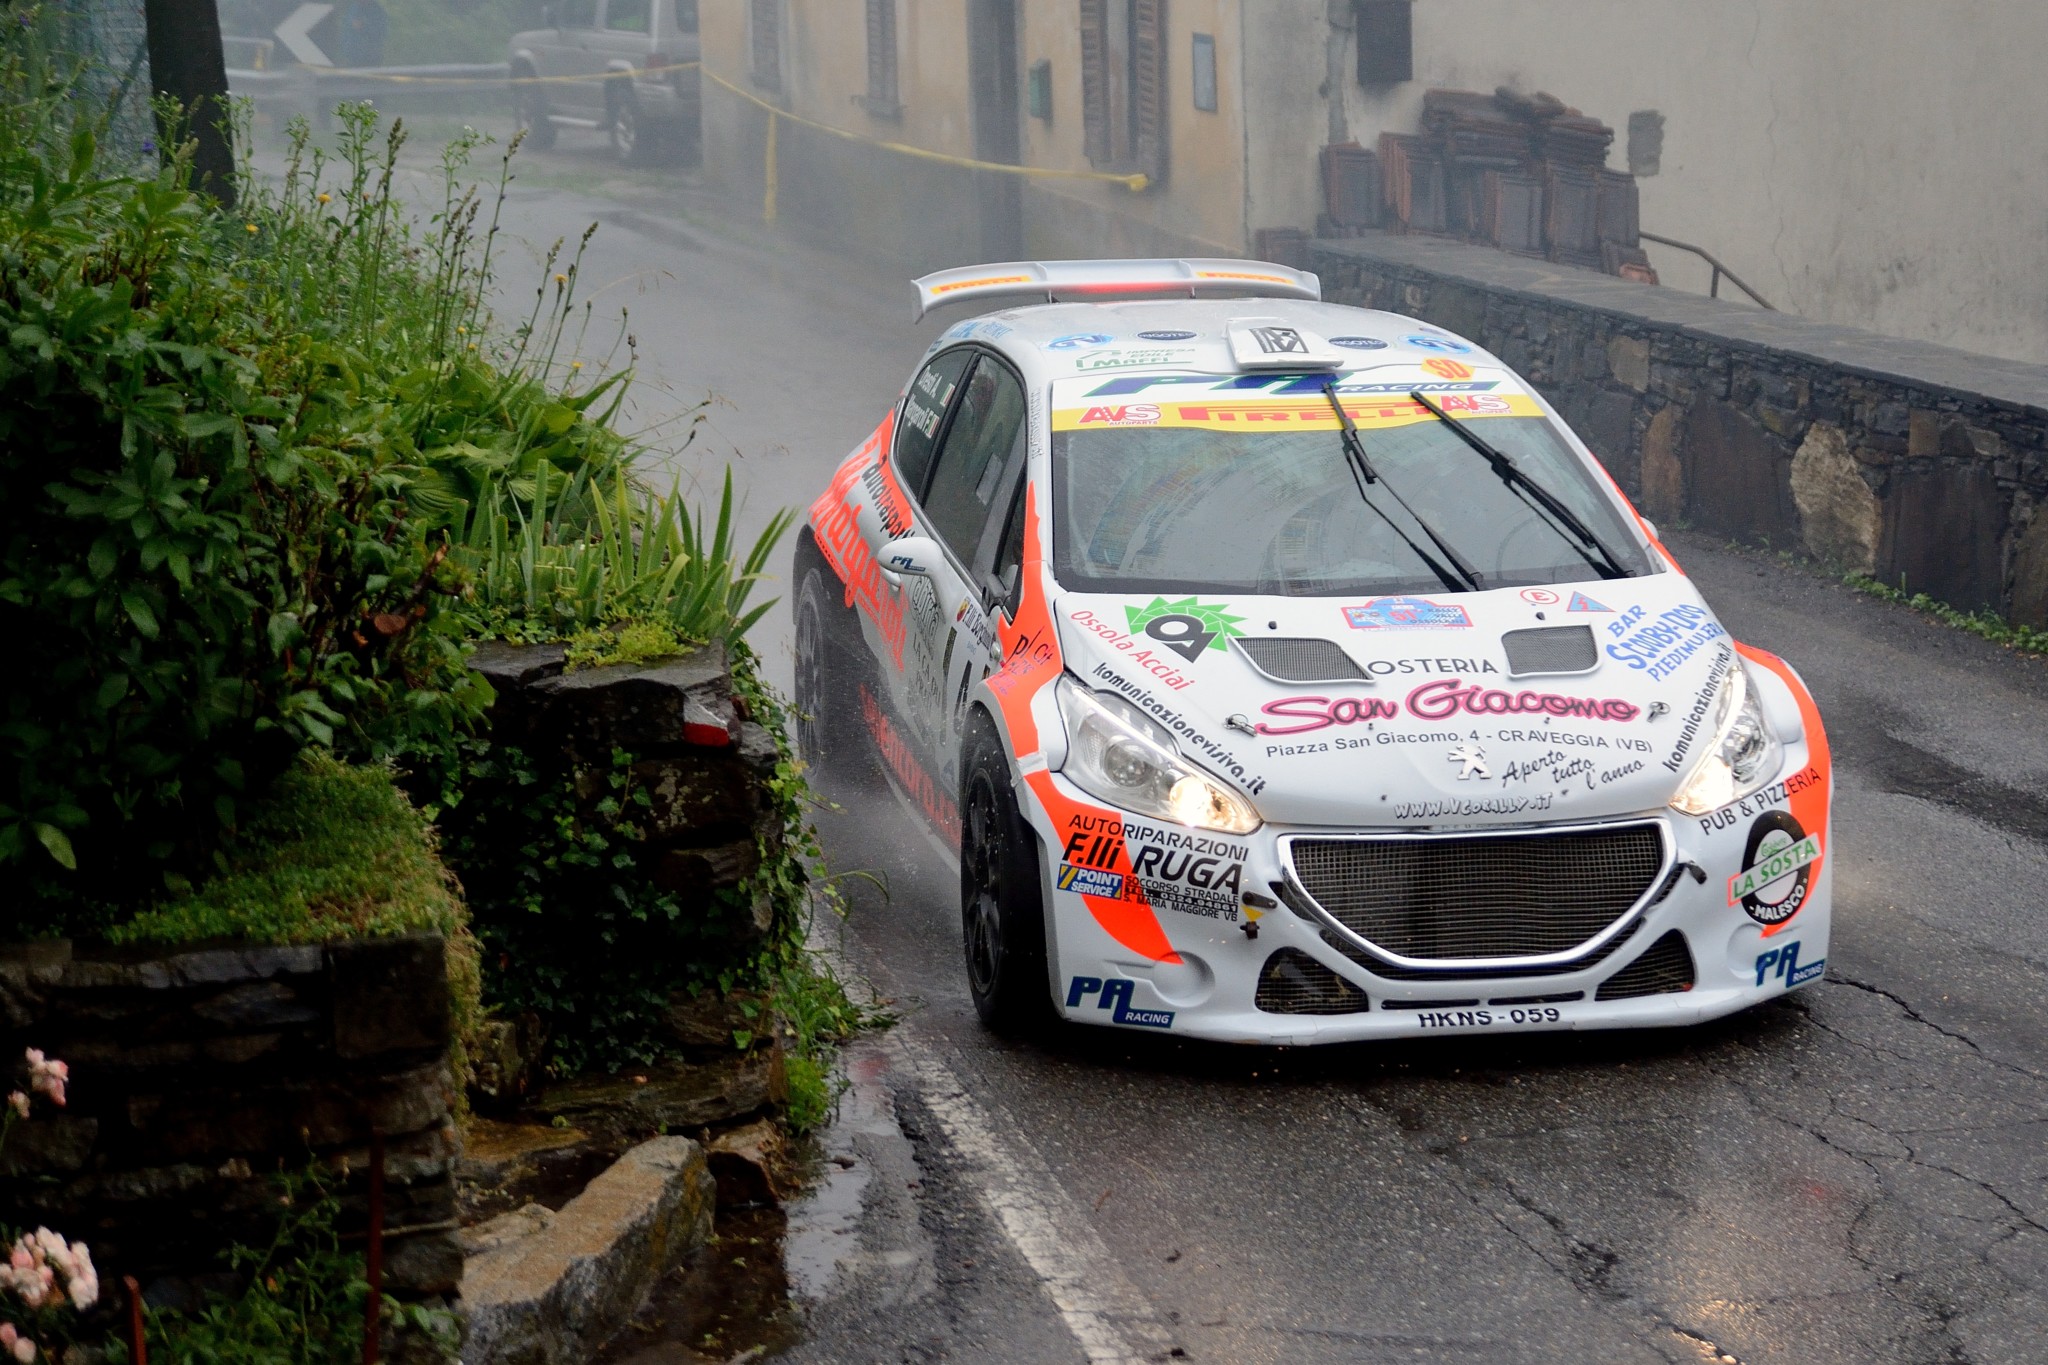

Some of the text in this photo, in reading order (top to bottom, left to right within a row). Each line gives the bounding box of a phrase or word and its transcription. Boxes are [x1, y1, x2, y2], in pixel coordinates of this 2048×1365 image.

[1425, 359, 1471, 379] SD
[1336, 383, 1475, 393] RACING
[1079, 404, 1162, 424] AVS
[1178, 401, 1432, 421] PIRELLI
[1440, 394, 1511, 412] AVS
[1530, 591, 1551, 601] E
[1607, 604, 1647, 638] BAR
[1070, 610, 1196, 691] Ossola Acciai
[1367, 658, 1499, 675] OSTERIA
[1255, 678, 1641, 736] San Giacomo
[1092, 662, 1267, 796] komunicazionevisiva.it
[1266, 741, 1329, 758] Piazza
[1335, 737, 1371, 751] San
[1376, 731, 1464, 745] Giacomo,
[1469, 729, 1480, 741] 4
[1498, 730, 1609, 748] CRAVEGGIA
[1616, 739, 1653, 753] (VB)
[1502, 750, 1567, 788] Aperto
[1552, 758, 1595, 784] tutto
[1700, 768, 1822, 835] PUB & PIZZERIA
[1068, 814, 1249, 862] AUTORIPARAZIONI
[1062, 832, 1243, 895] F.lli RUGA
[1733, 875, 1755, 898] LA
[1761, 840, 1817, 884] SOSTA
[1071, 881, 1113, 897] SERVICE
[1076, 870, 1123, 887] POINT
[1125, 875, 1239, 904] SOCCORSO STRADALE
[1137, 895, 1167, 909] MARIA
[1171, 901, 1219, 919] MAGGIORE
[1224, 912, 1238, 921] VB
[1756, 940, 1801, 987] PA
[1792, 963, 1823, 982] RACING
[1066, 976, 1136, 1015] PA
[1125, 1011, 1170, 1024] RACING
